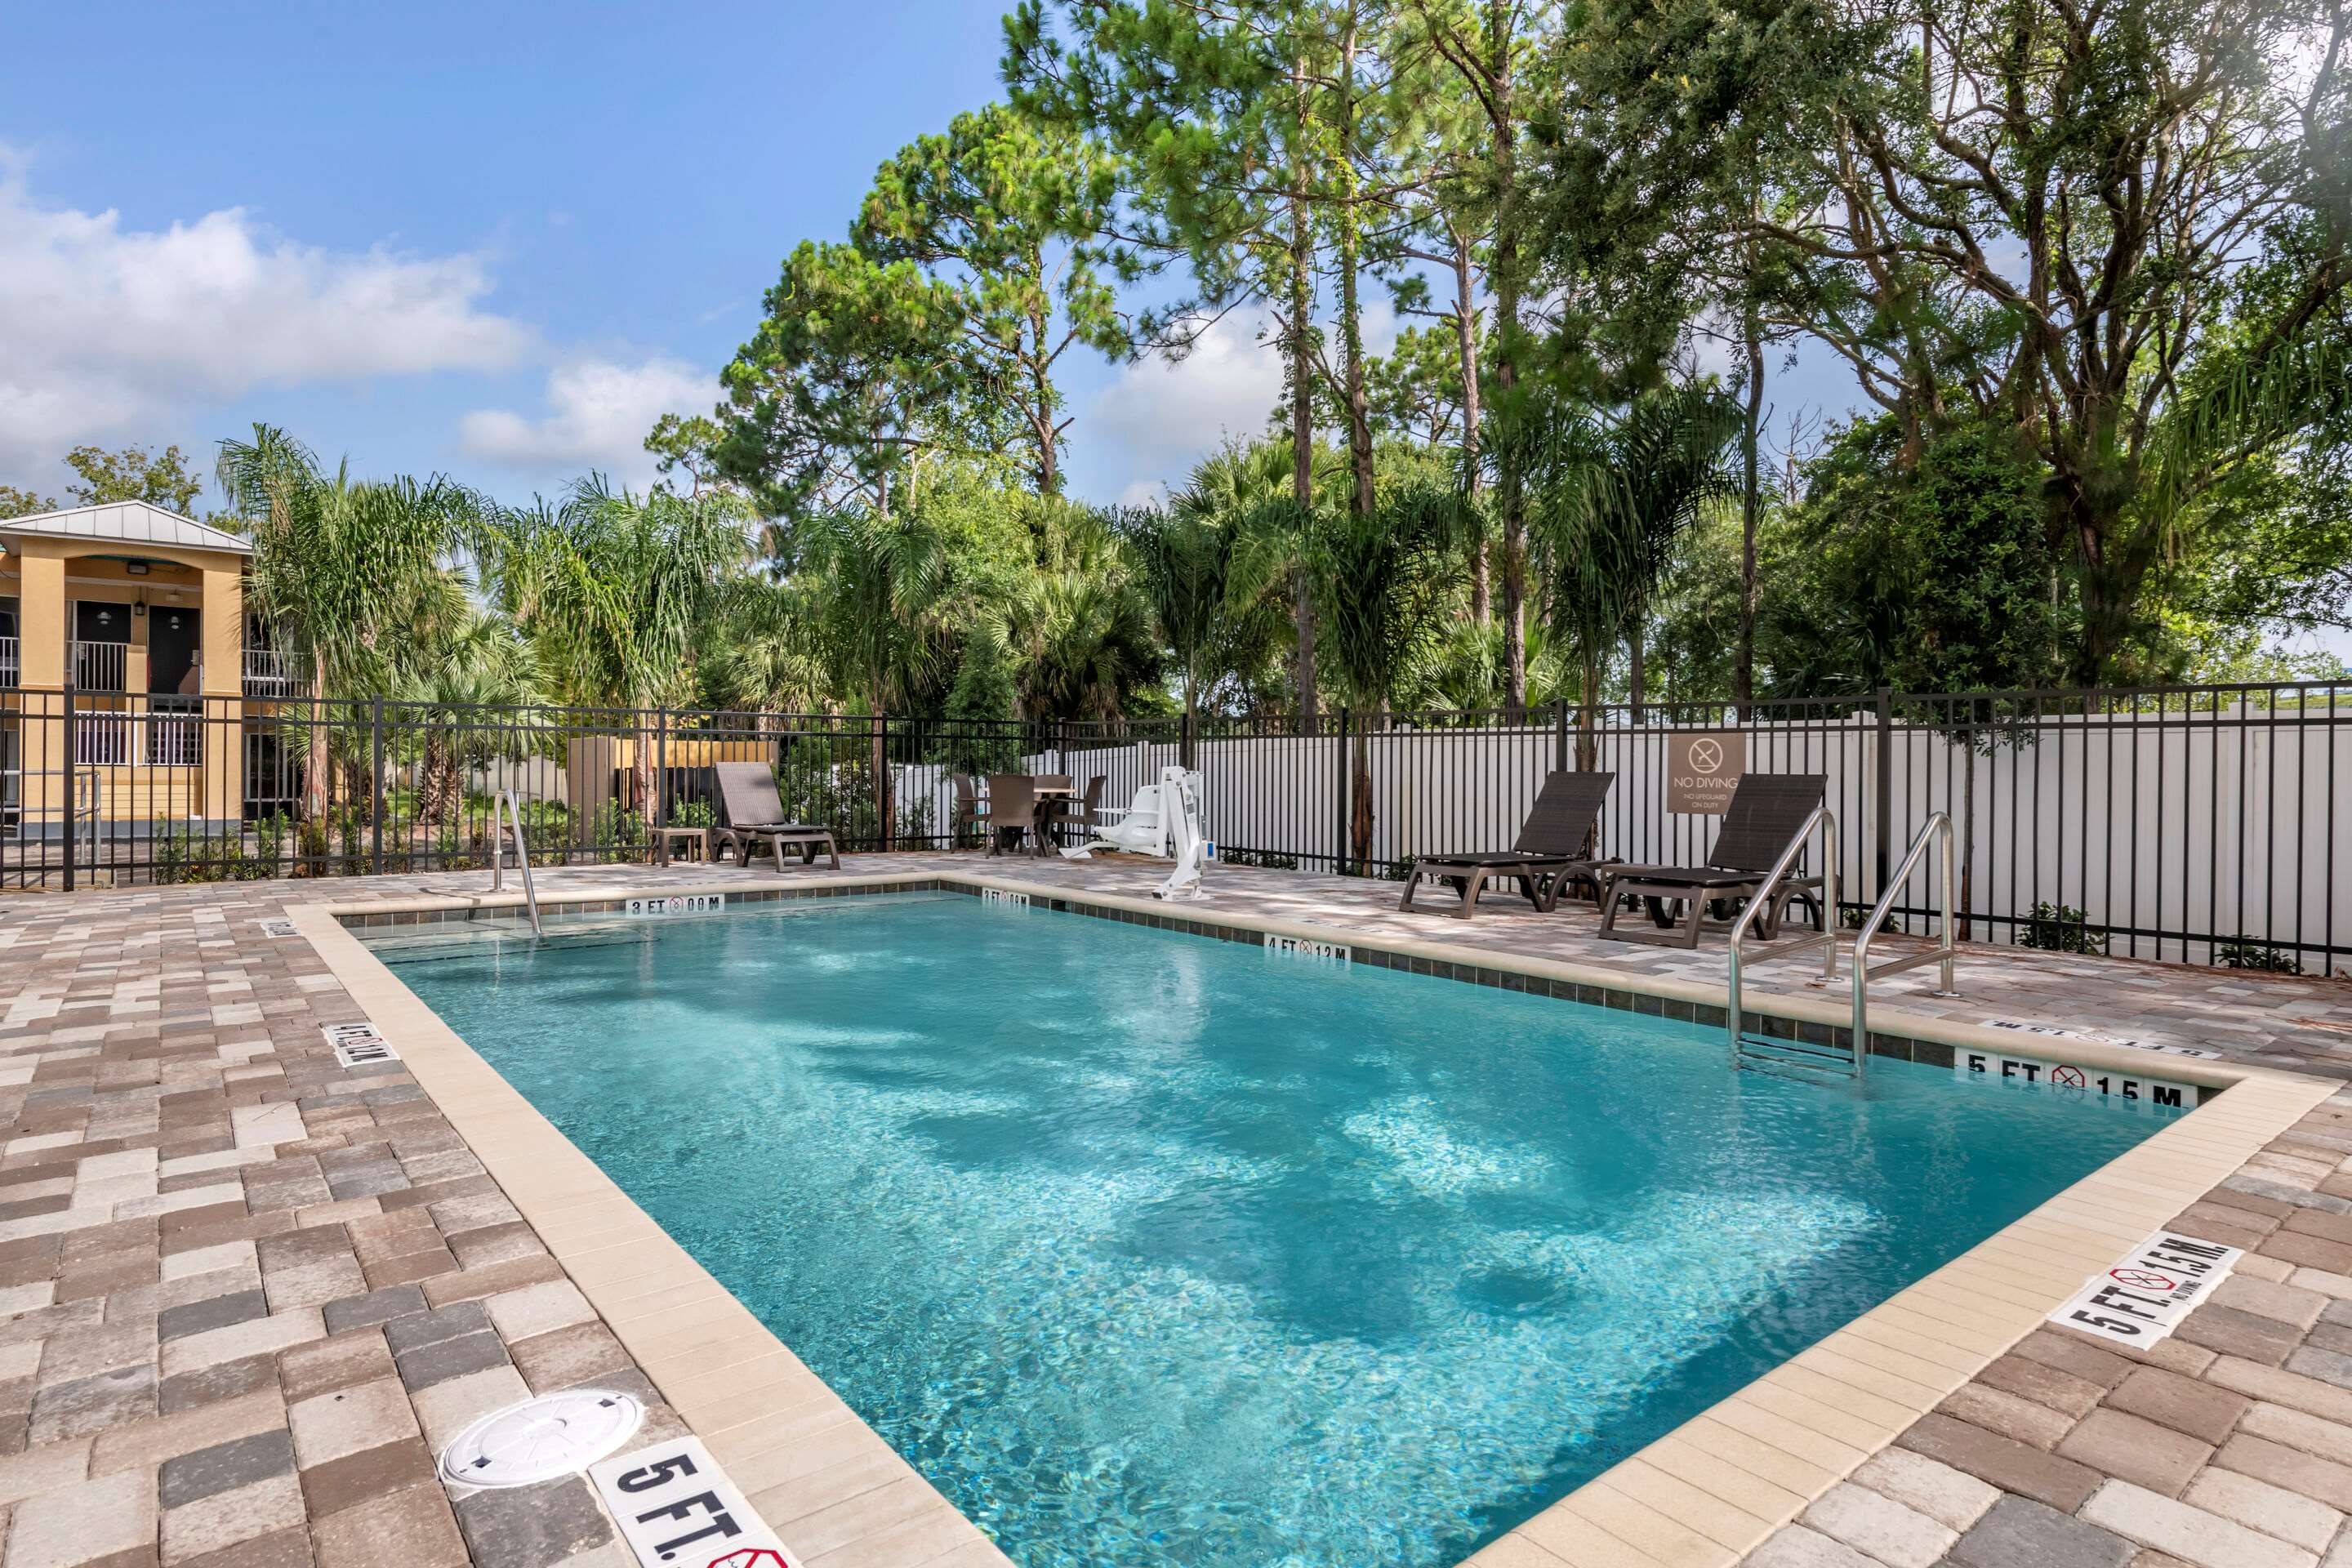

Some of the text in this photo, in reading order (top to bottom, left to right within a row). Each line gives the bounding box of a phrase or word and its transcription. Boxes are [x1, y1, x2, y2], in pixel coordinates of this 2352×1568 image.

[1674, 777, 1739, 789] NO DIVING
[648, 900, 665, 911] FT
[1281, 939, 1296, 951] FT
[1968, 1054, 1986, 1073] 5
[2069, 1309, 2141, 1335] 5
[2138, 1250, 2212, 1277] 1.5
[617, 1454, 742, 1561] 5 FT.
